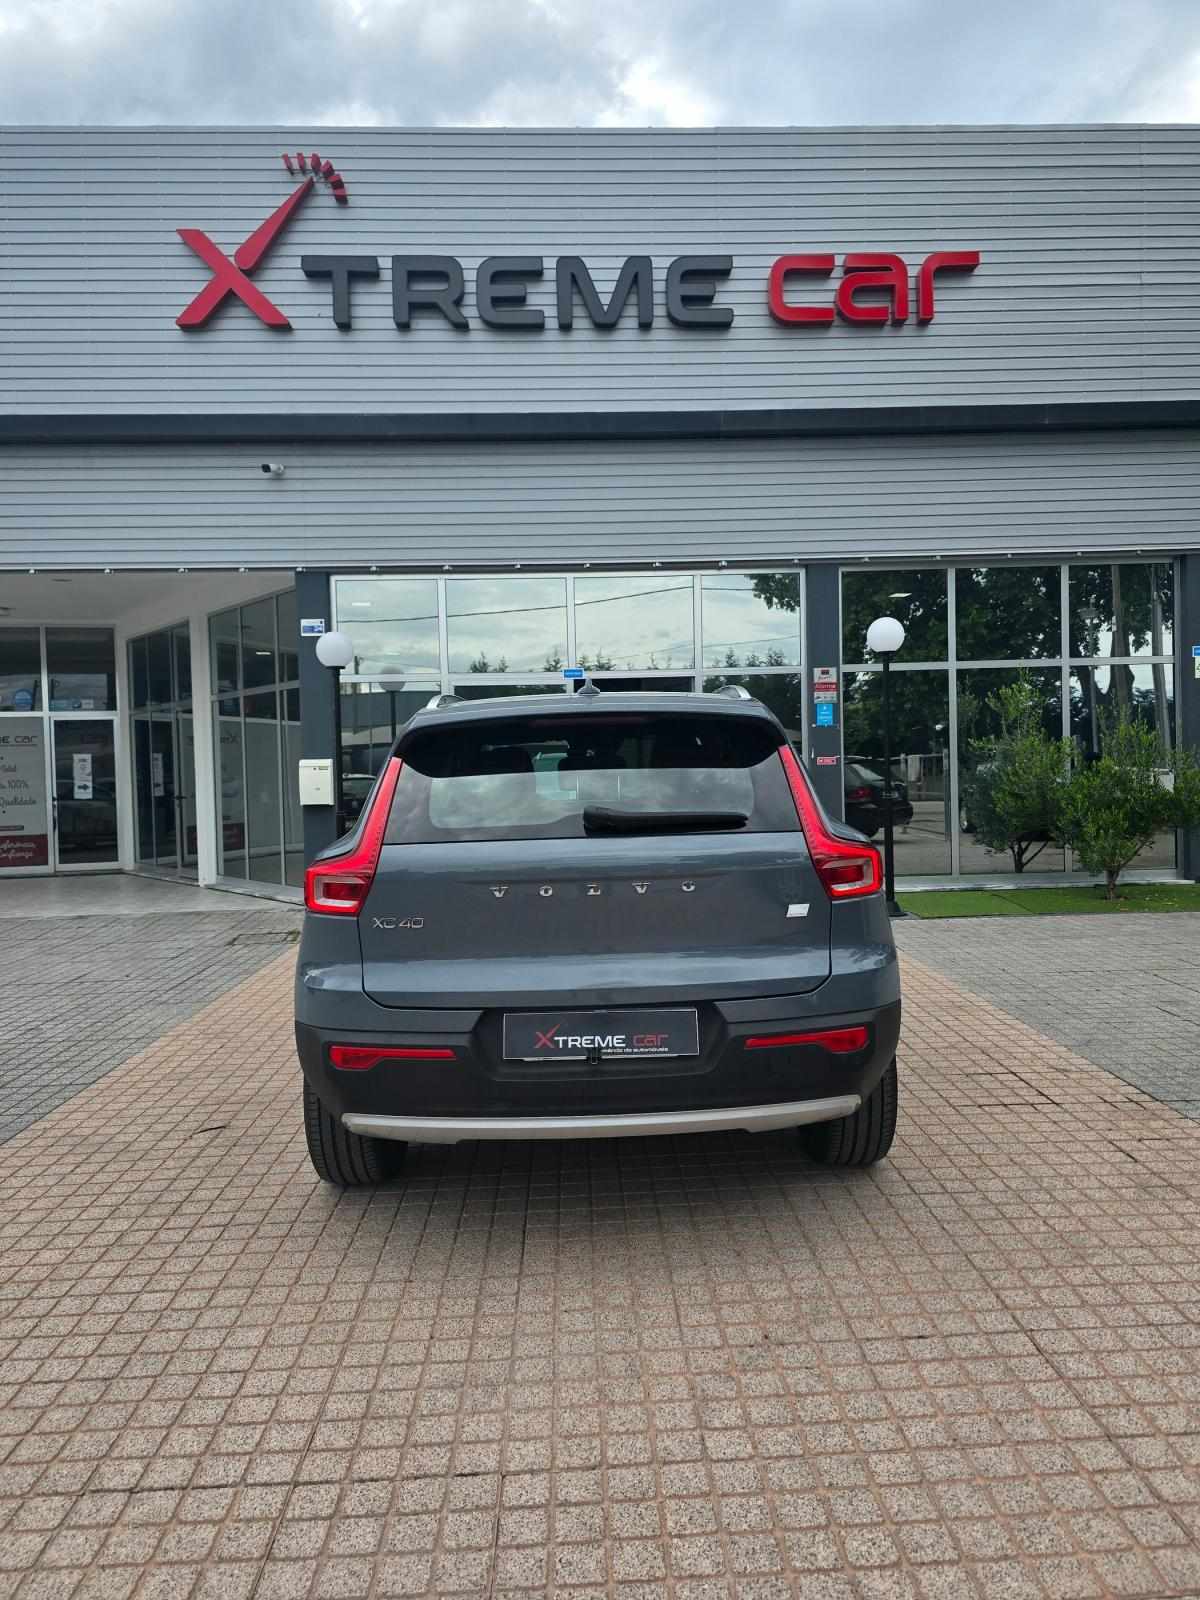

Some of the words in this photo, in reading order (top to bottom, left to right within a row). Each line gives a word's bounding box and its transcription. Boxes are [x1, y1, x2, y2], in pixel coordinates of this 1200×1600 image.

[175, 175, 735, 330] XTREME
[769, 251, 981, 325] car
[489, 880, 697, 899] VOLVO
[535, 1024, 626, 1048] XTREME
[632, 1034, 669, 1047] car
